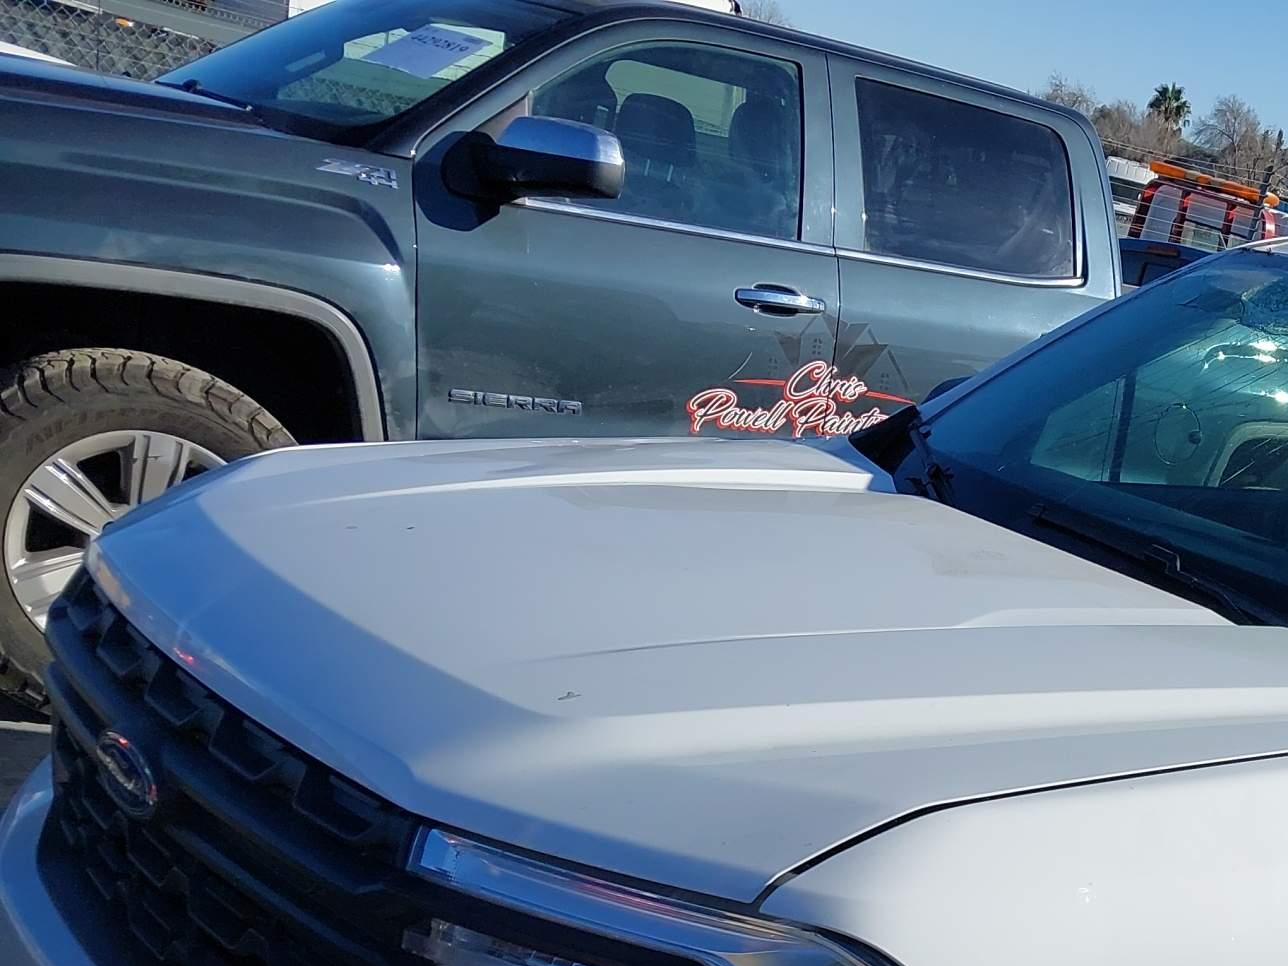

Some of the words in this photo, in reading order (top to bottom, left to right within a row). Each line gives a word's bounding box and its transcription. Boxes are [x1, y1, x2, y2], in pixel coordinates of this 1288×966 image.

[448, 388, 583, 416] SIERRA
[785, 360, 868, 402] Chris
[688, 388, 794, 434] Powell
[790, 396, 891, 439] Paint
